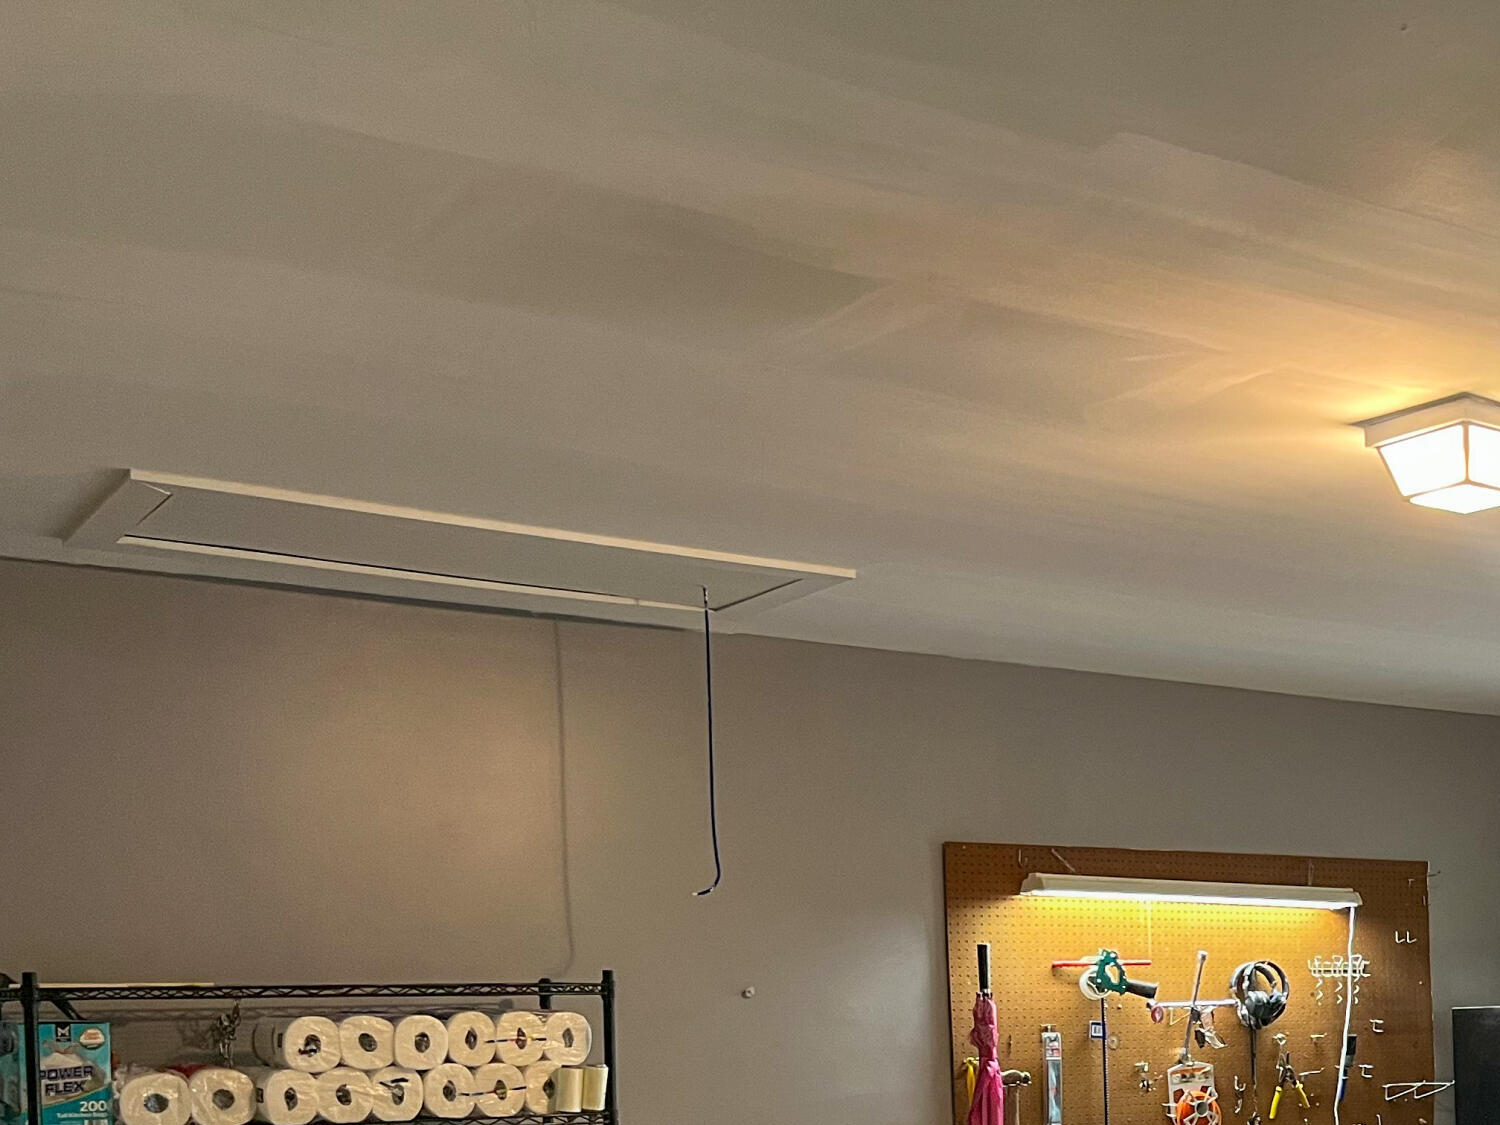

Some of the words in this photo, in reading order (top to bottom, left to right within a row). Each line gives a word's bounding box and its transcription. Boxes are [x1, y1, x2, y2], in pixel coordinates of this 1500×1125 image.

[40, 1065, 93, 1080] POWER
[45, 1081, 85, 1094] FLEX
[80, 1101, 107, 1112] 200
